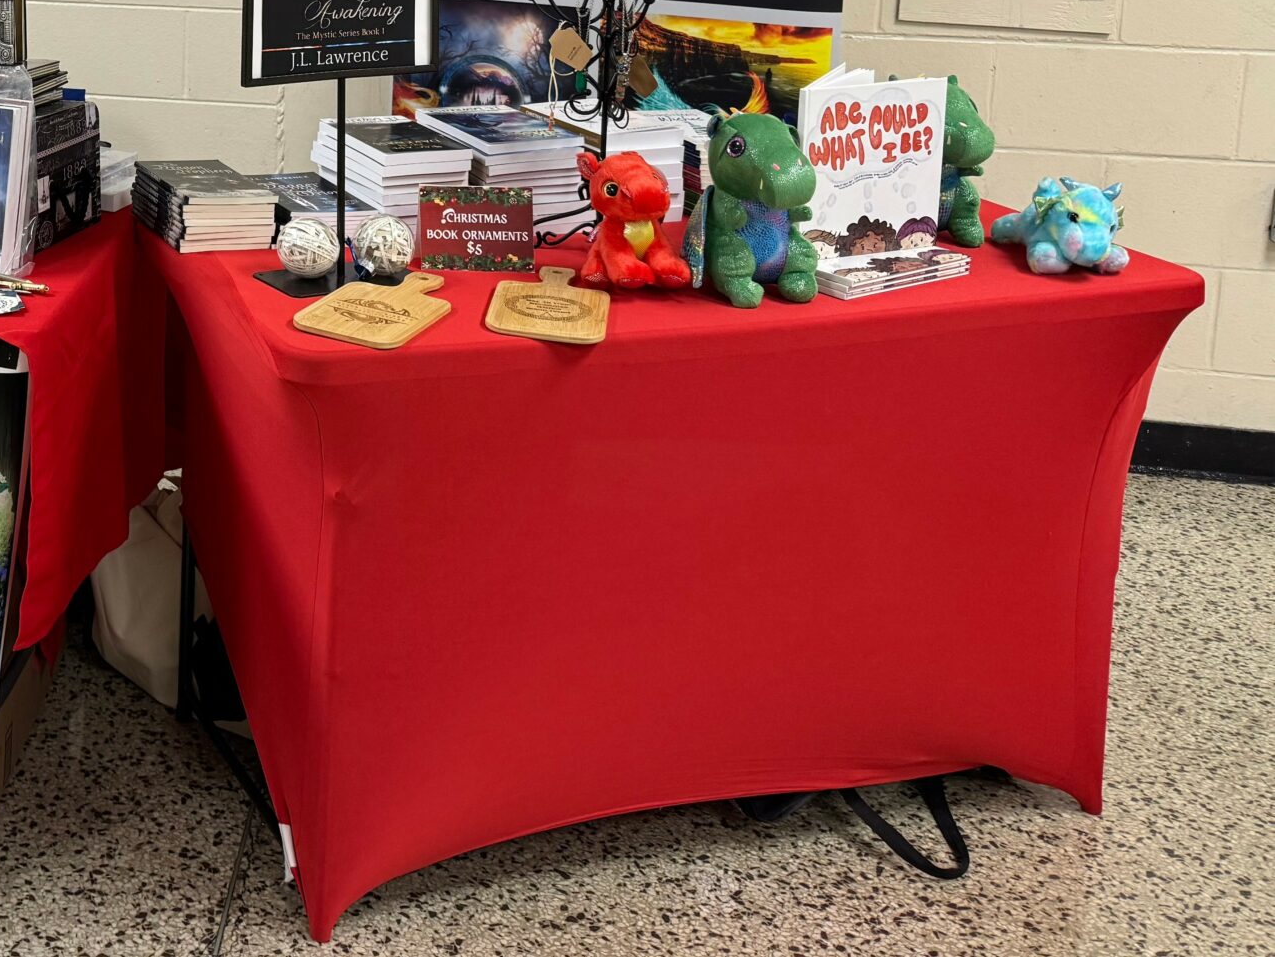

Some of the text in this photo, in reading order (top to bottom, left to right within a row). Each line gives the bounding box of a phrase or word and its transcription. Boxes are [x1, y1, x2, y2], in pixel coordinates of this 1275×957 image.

[296, 32, 310, 40] The
[312, 30, 336, 40] Mystic
[338, 29, 360, 37] Series
[361, 28, 380, 36] Book
[290, 49, 389, 71] J.L. Lawrence
[820, 101, 929, 150] ABC, COULD
[808, 126, 933, 171] WHAT I BE?
[445, 212, 508, 224] CHRISTMAS
[426, 228, 529, 242] BOOK ORNAMENTS
[467, 240, 483, 255] $5
